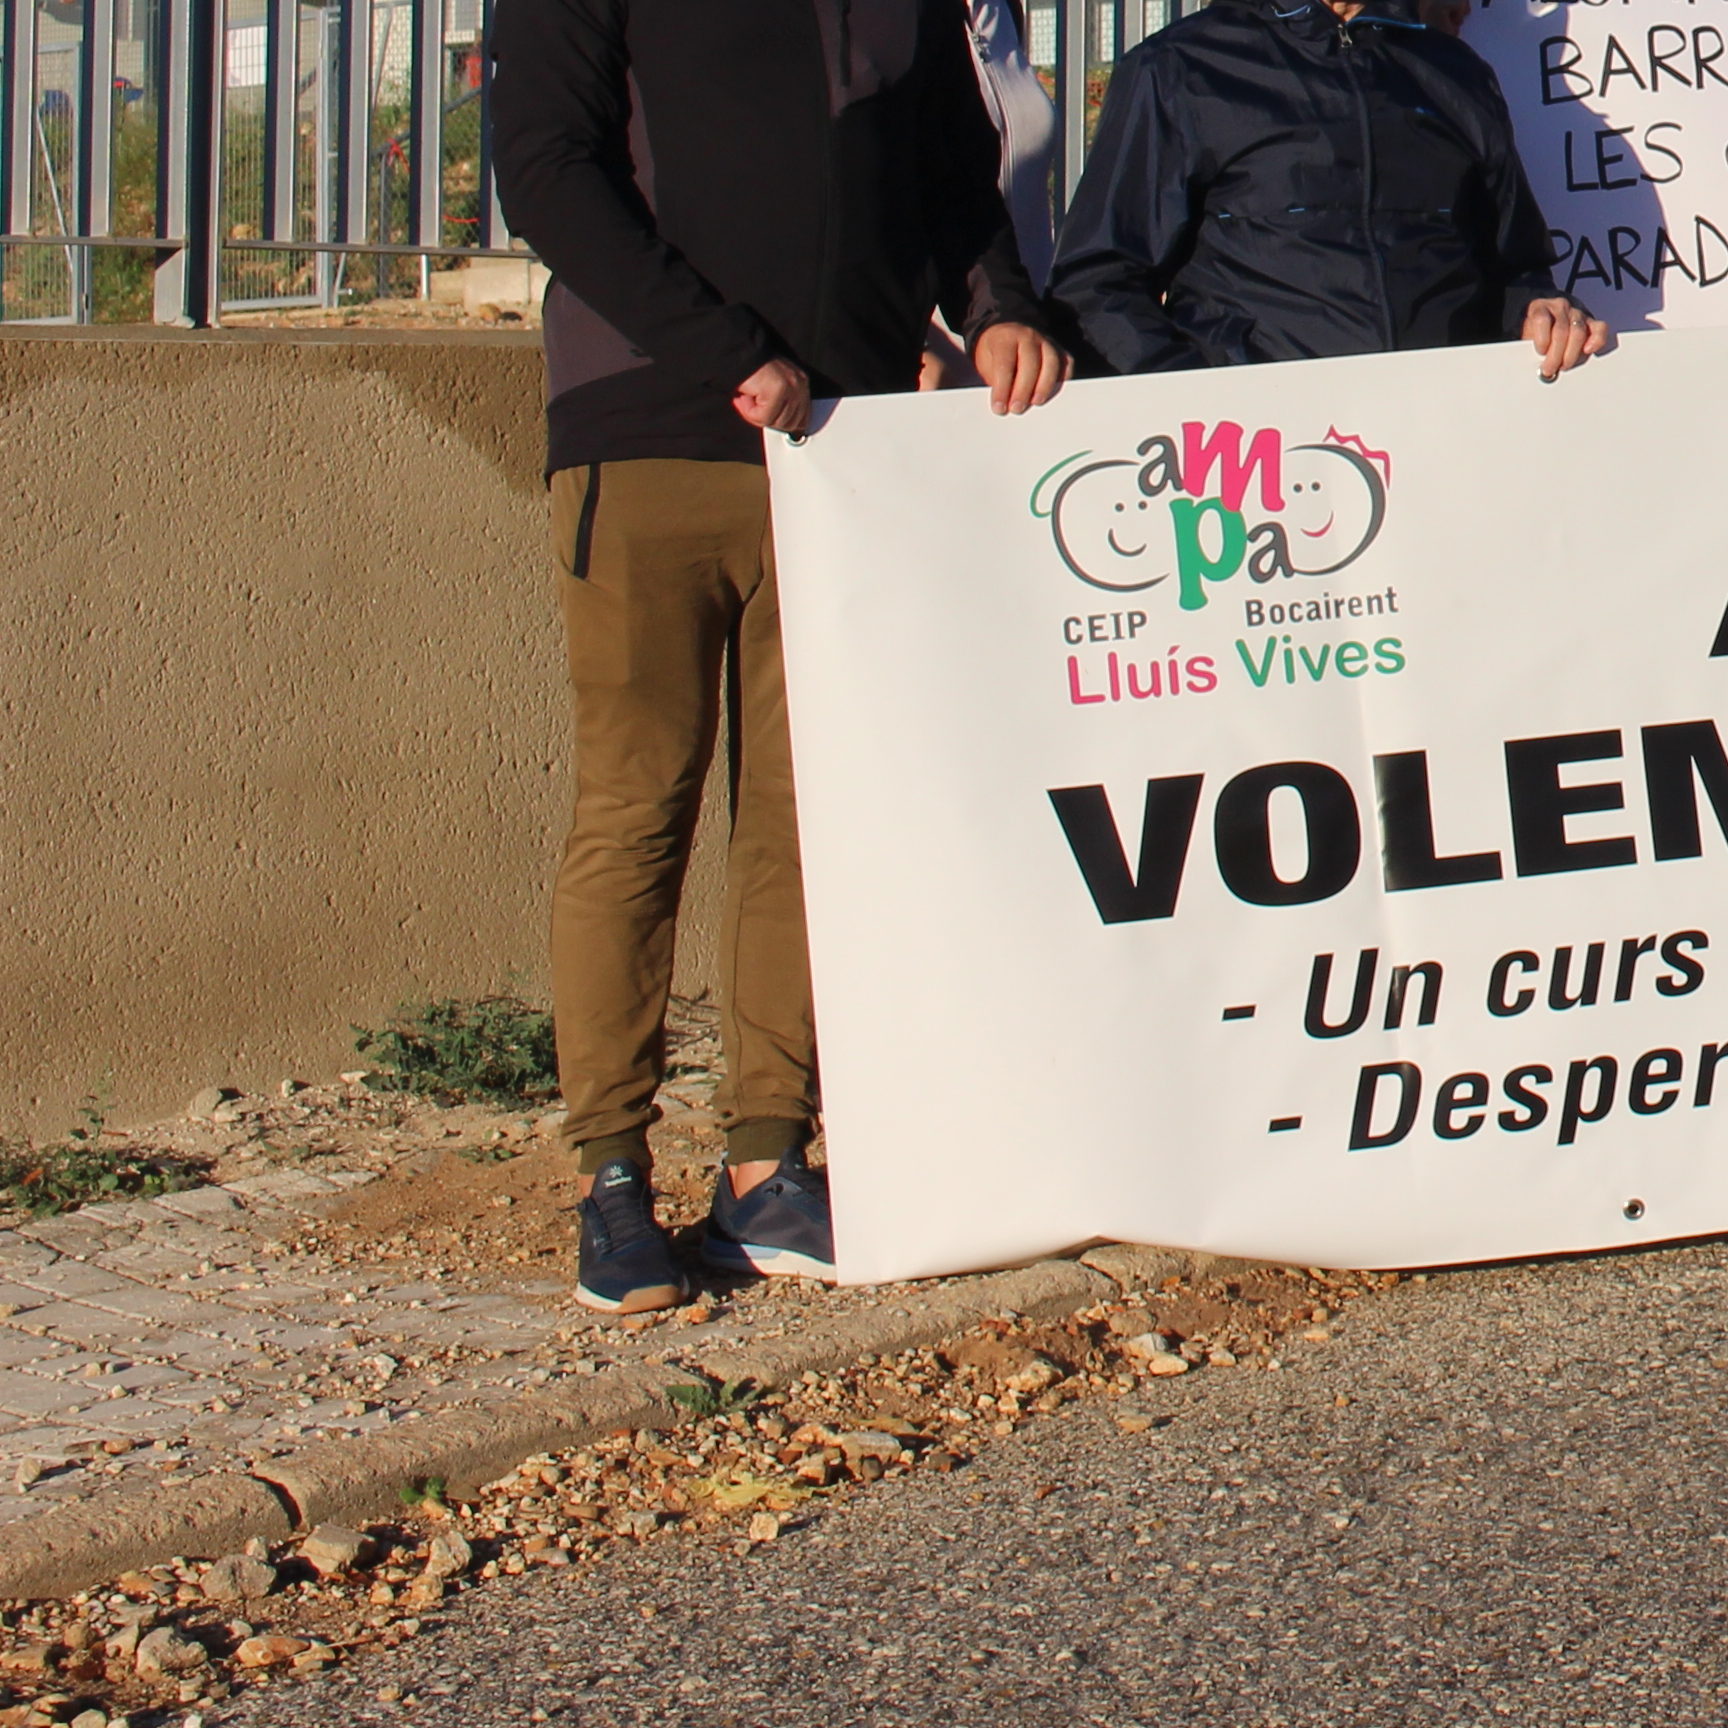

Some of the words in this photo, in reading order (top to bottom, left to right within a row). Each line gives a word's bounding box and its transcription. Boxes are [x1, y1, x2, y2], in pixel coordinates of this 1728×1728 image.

[1565, 123, 1684, 193] LES
[1064, 612, 1146, 644] CEIP
[1246, 588, 1396, 626] Bocairent
[1068, 647, 1216, 703] Lluís
[1237, 636, 1404, 686] Vives
[1304, 948, 1443, 1039] Un
[1487, 930, 1708, 1017] curs
